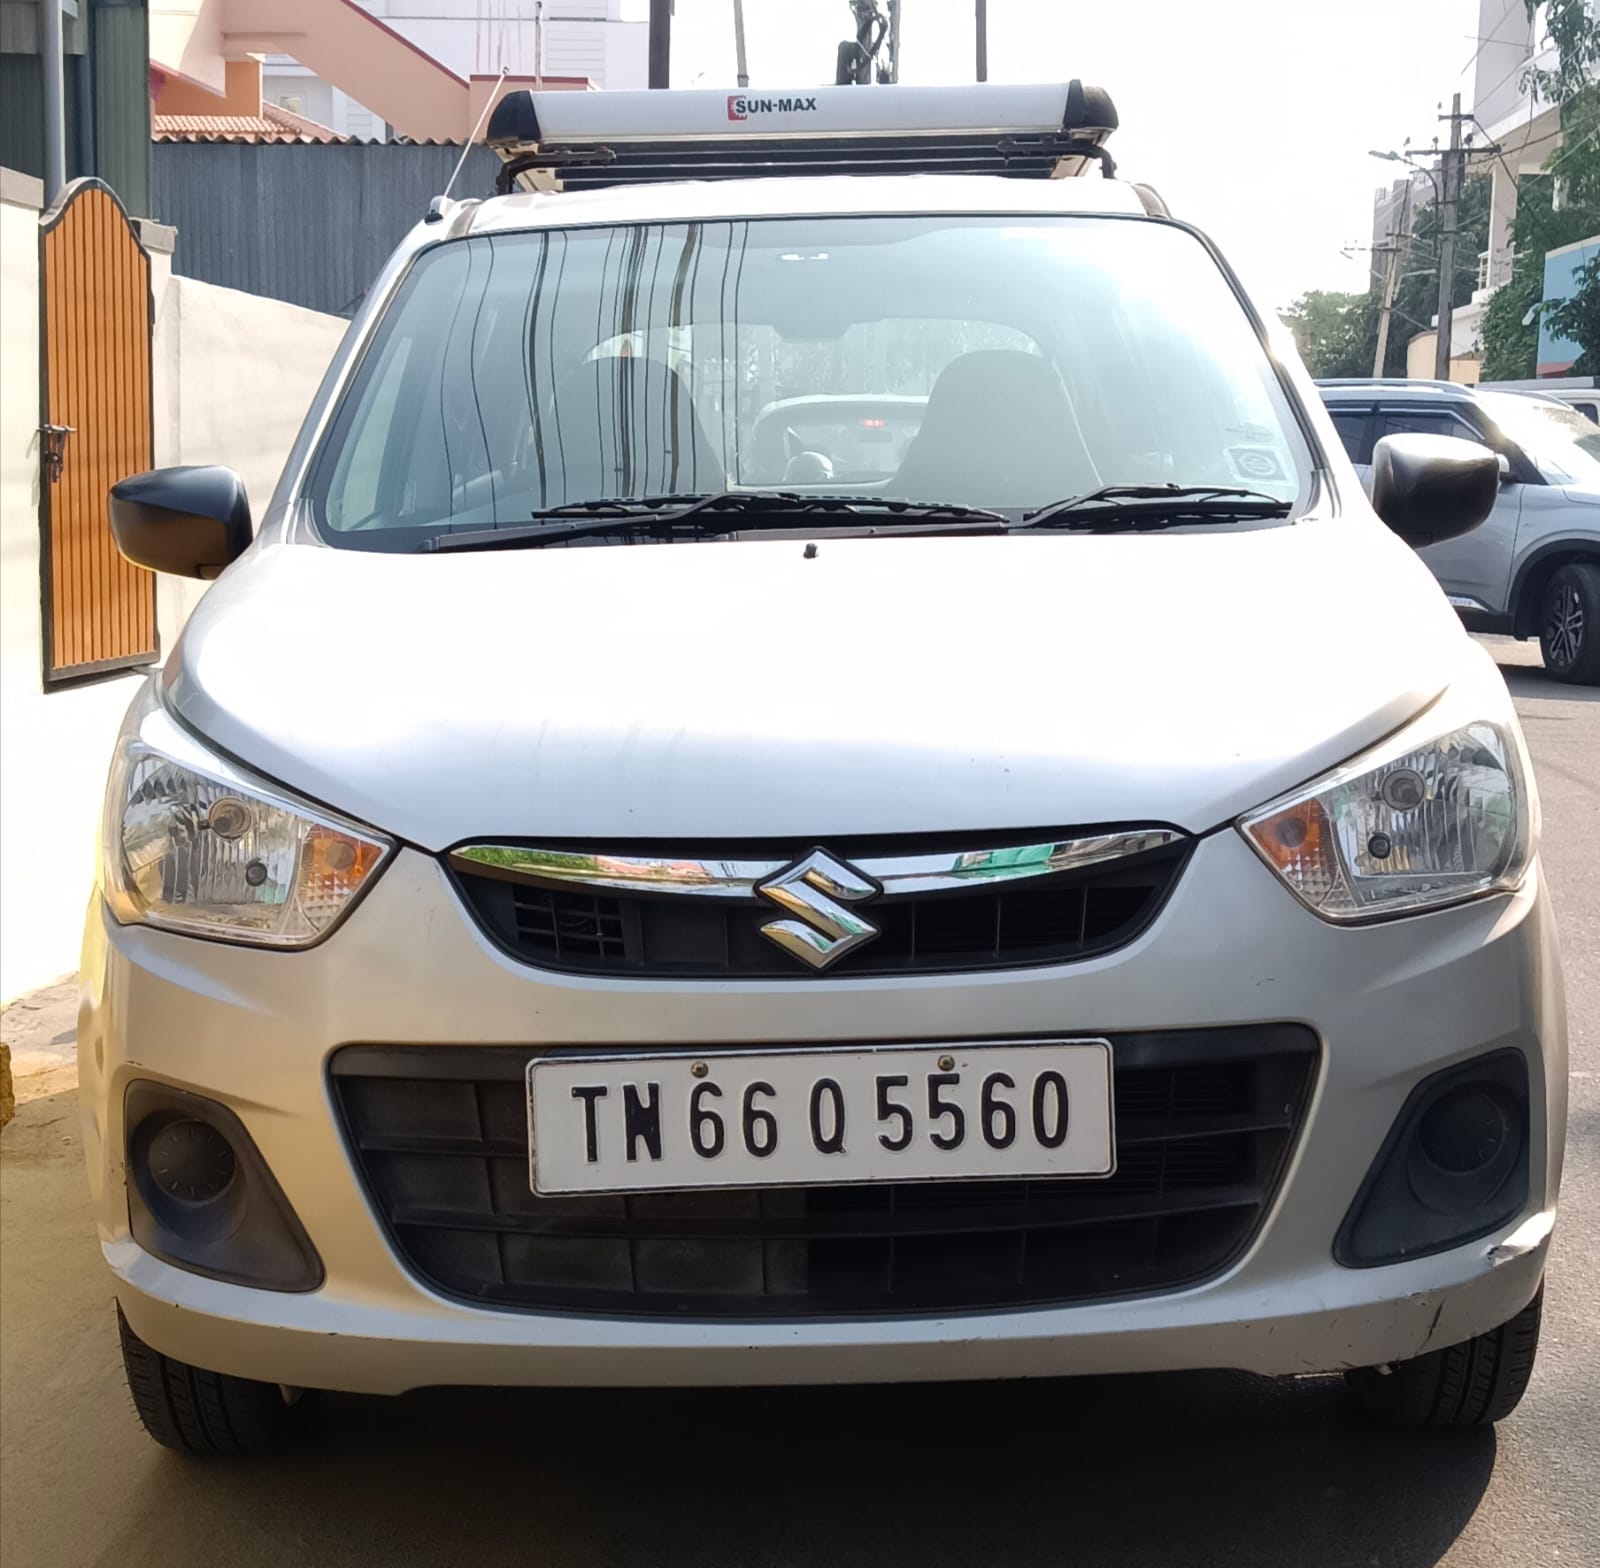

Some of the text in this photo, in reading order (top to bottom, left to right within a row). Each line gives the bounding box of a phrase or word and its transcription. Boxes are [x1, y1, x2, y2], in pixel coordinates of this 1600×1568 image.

[735, 97, 817, 113] SUN-MAX
[570, 1070, 1070, 1162] TN 66 Q 5560
